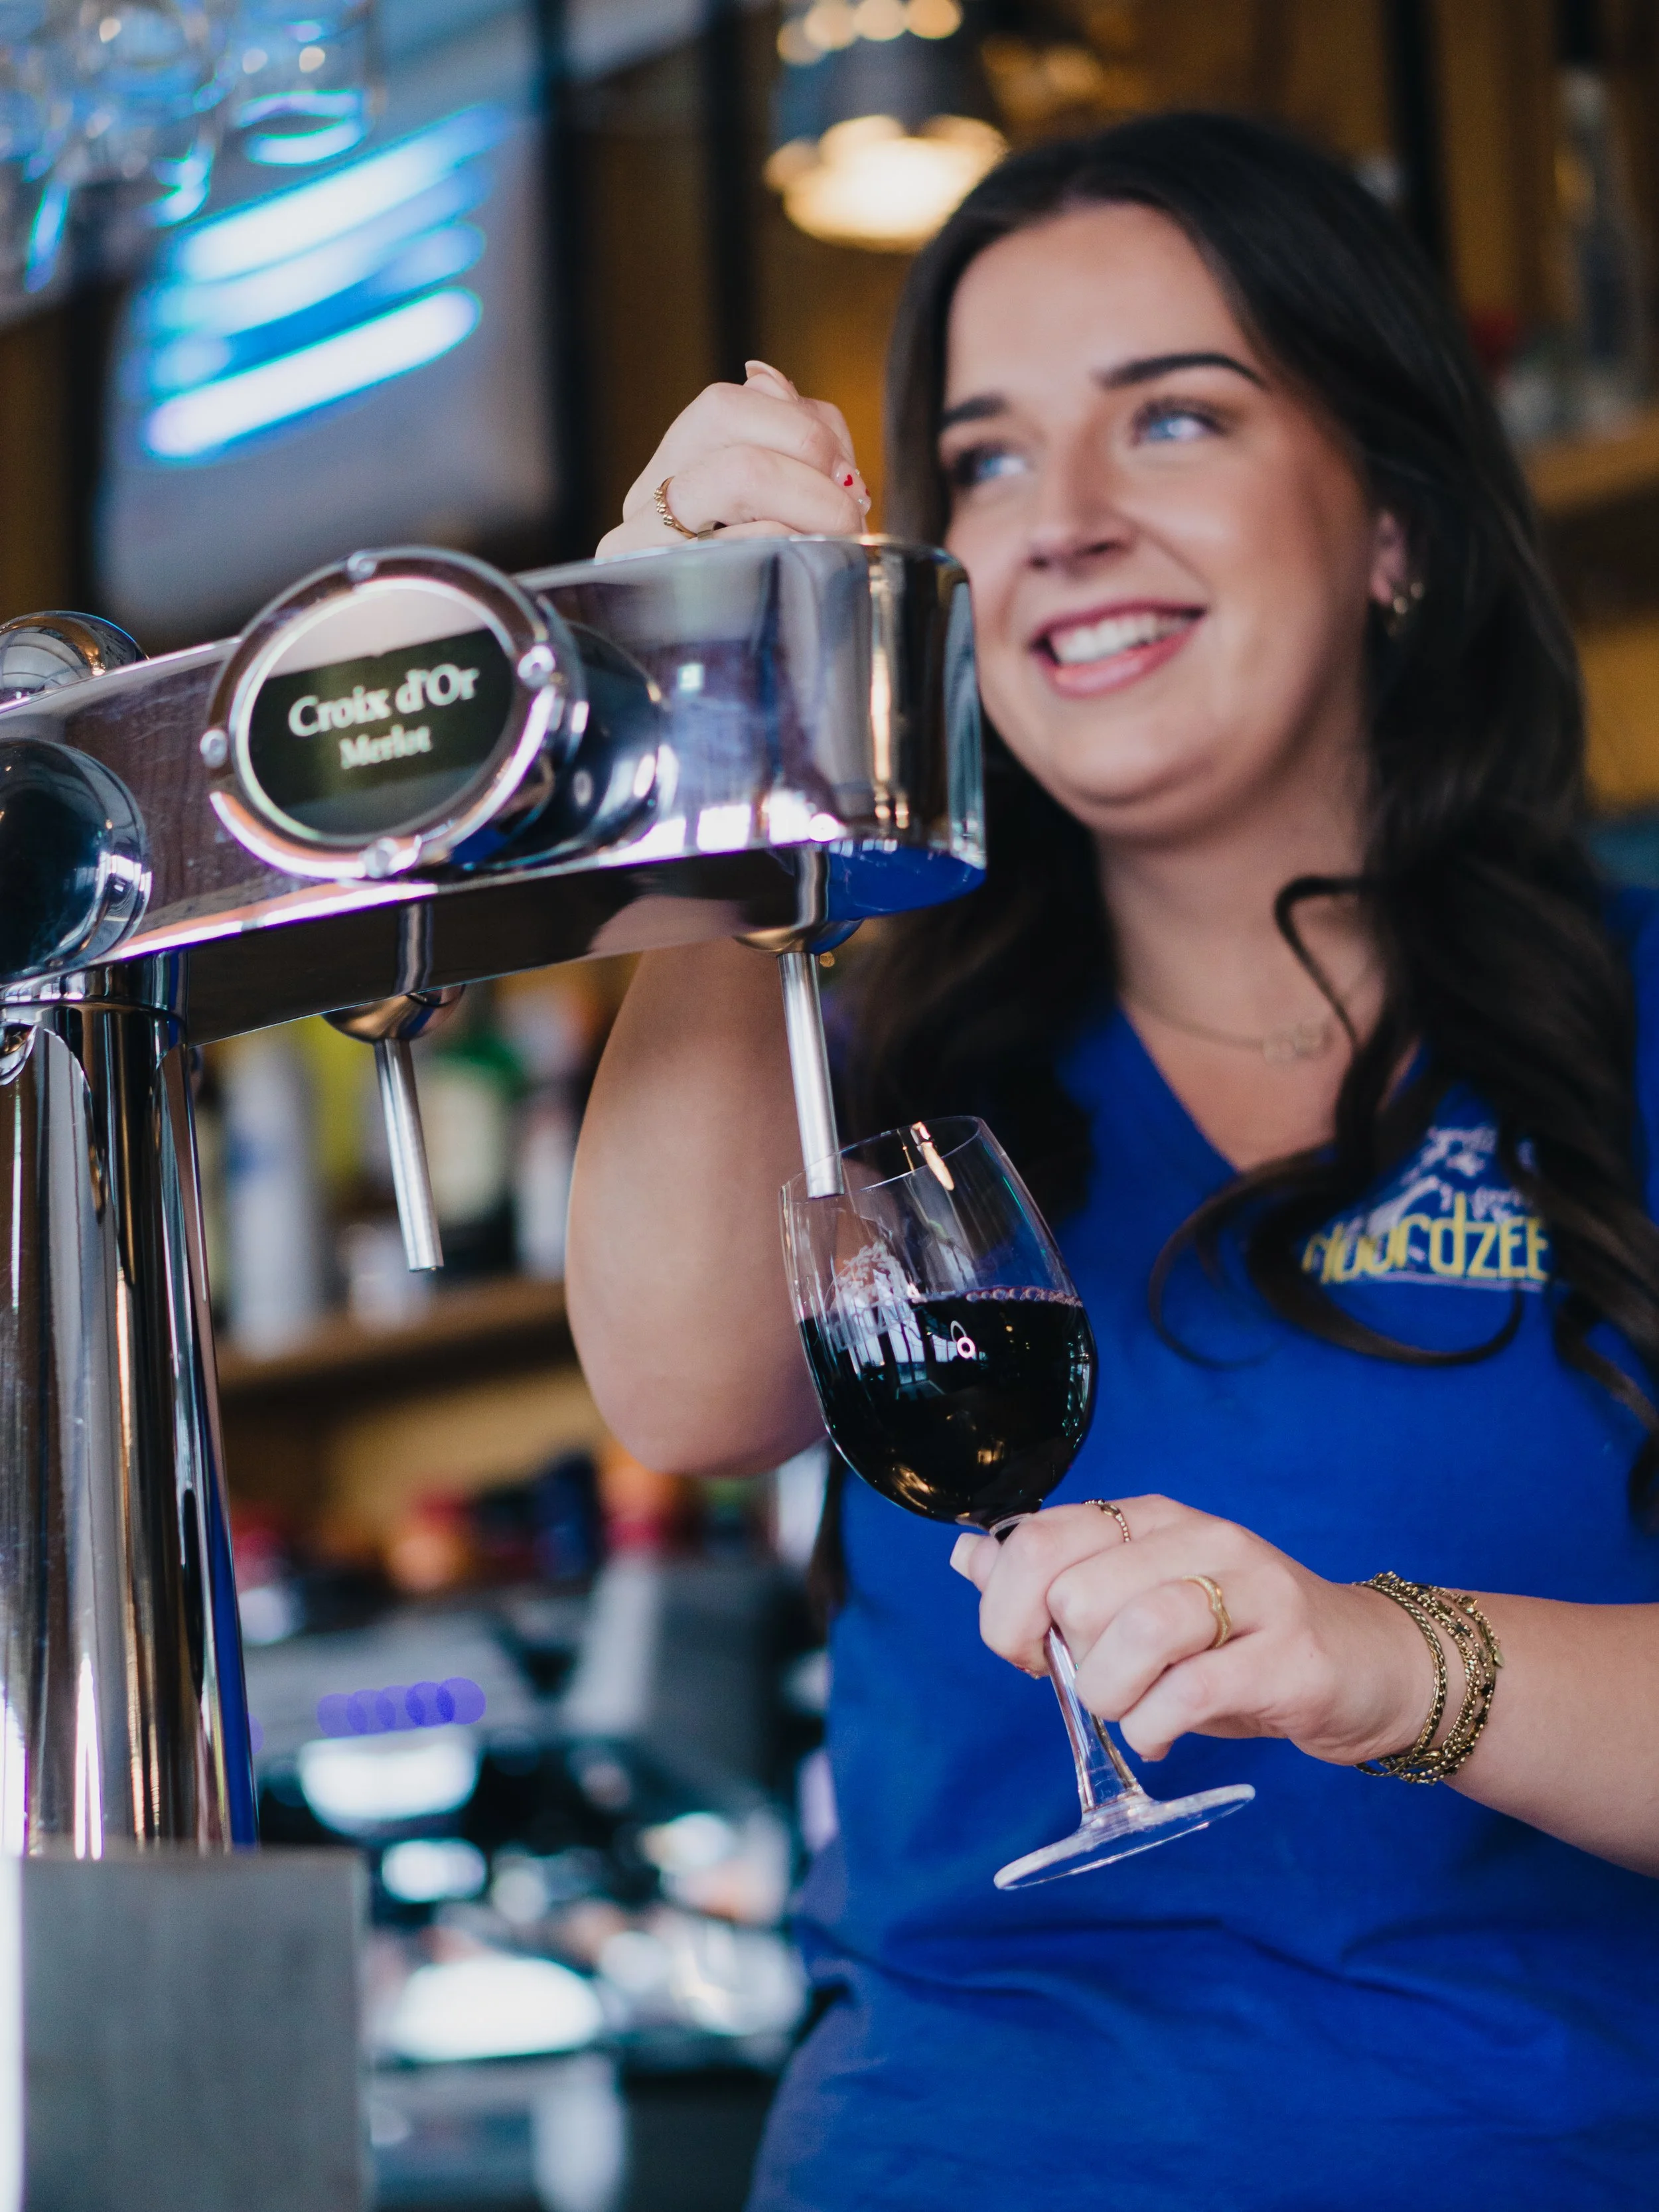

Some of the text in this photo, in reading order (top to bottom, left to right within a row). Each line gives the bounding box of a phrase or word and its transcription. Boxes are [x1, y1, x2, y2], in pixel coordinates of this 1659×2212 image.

[288, 663, 480, 737] Croix d'Or
[339, 723, 432, 770] Merlot
